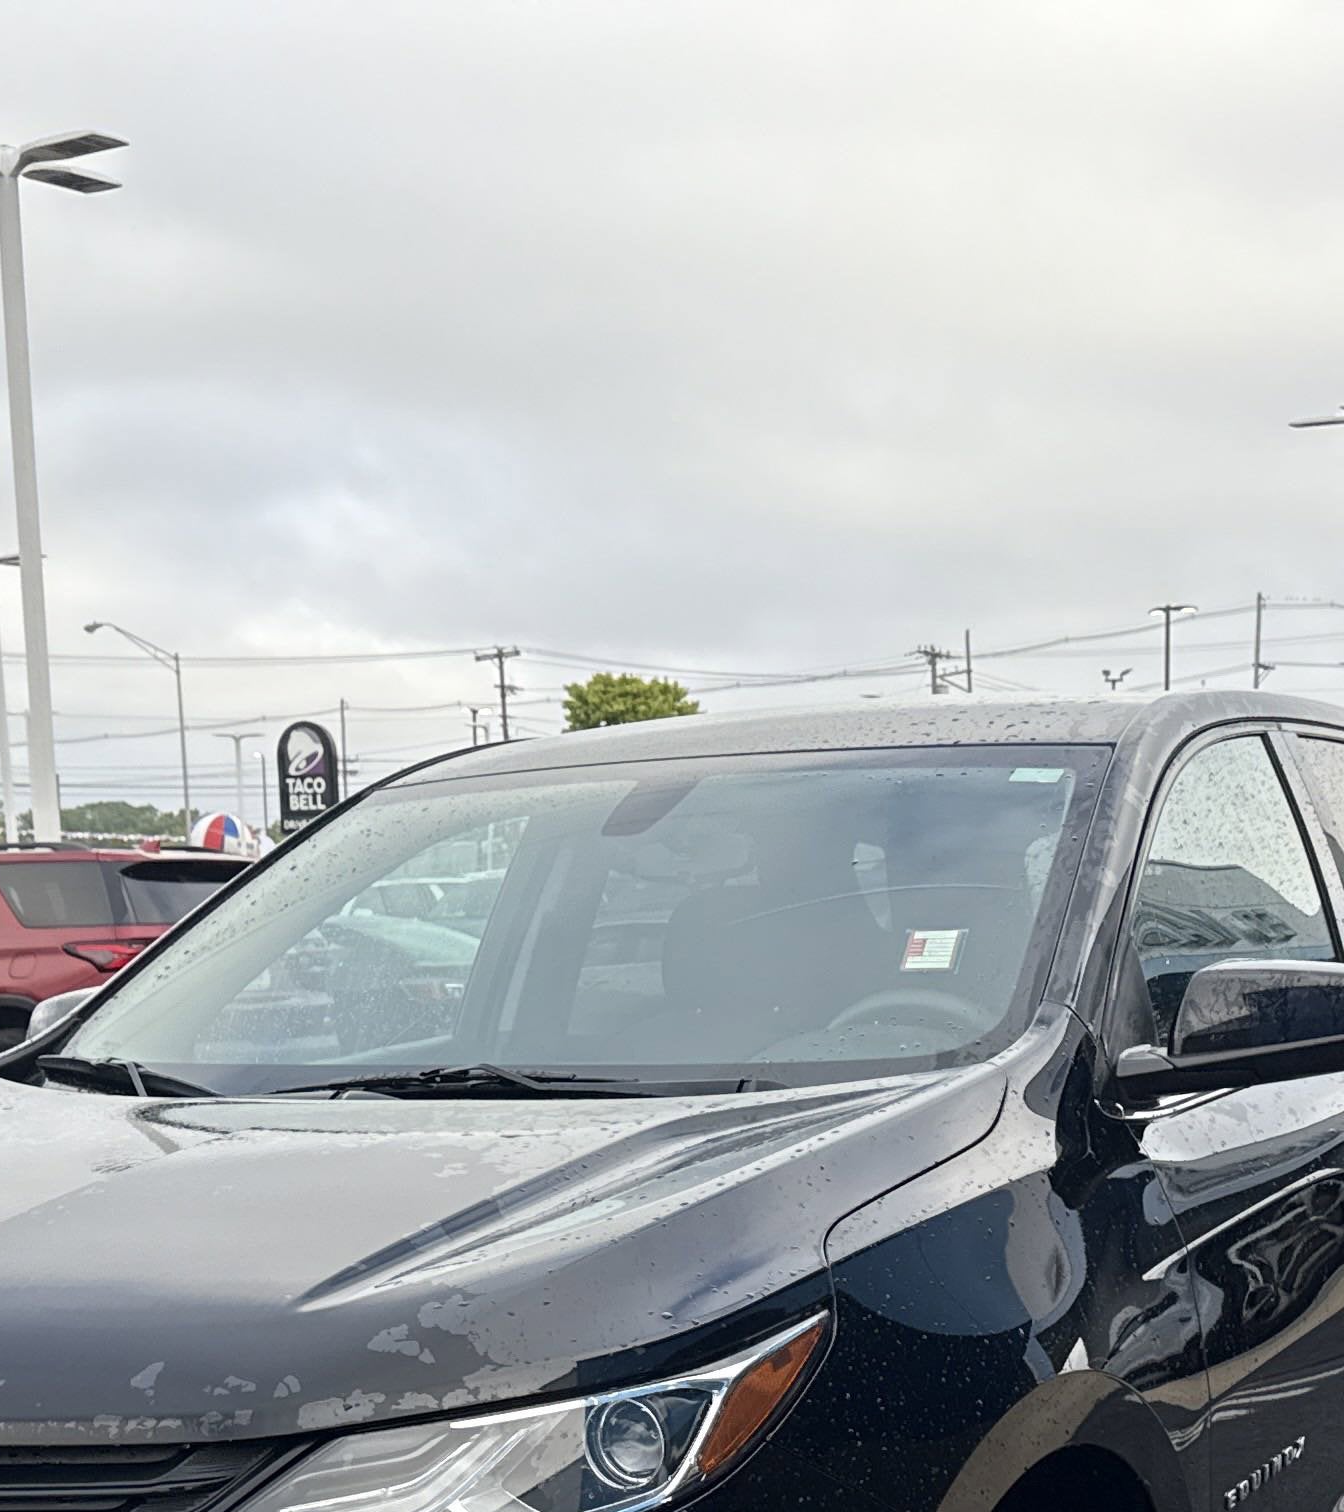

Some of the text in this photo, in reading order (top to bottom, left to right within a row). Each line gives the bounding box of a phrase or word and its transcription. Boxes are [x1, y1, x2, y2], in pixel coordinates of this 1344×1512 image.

[285, 776, 327, 794] TACO
[289, 794, 327, 811] BELL
[1224, 1435, 1306, 1510] EQUINOX
